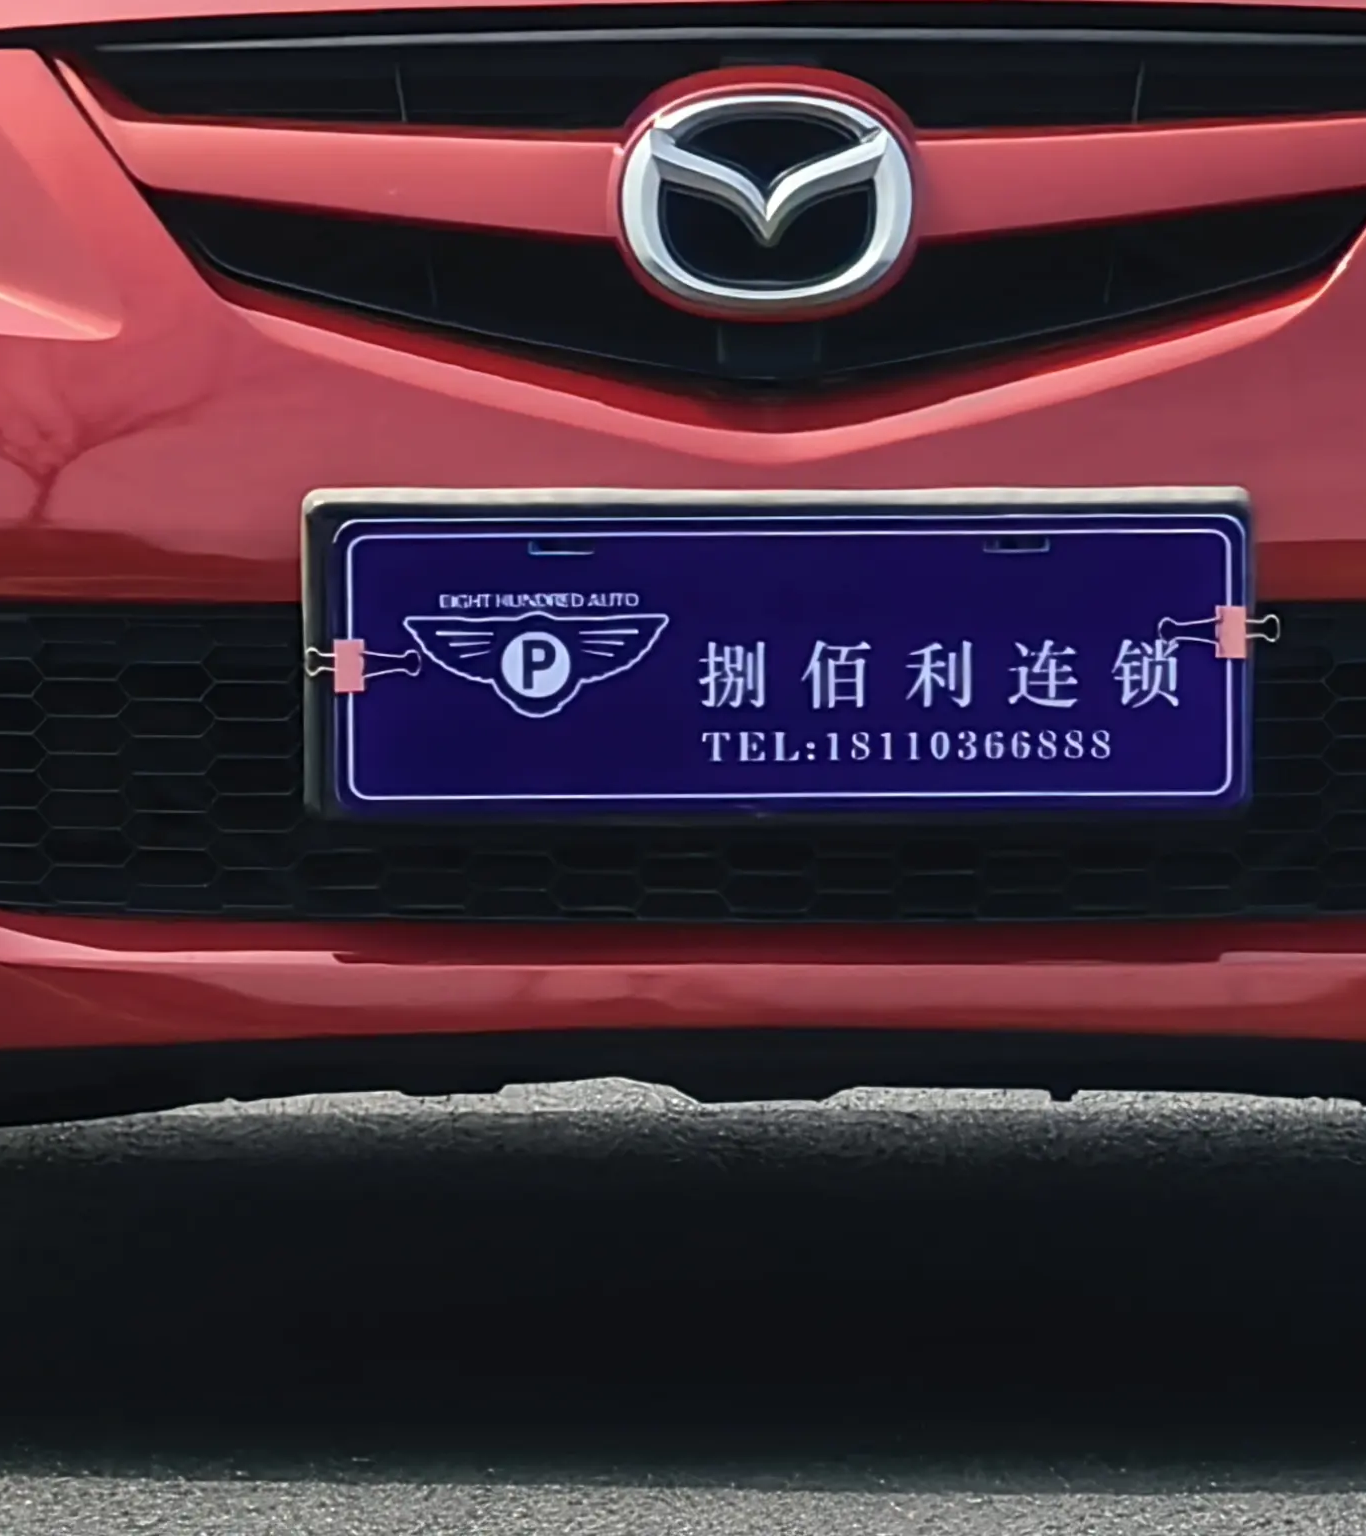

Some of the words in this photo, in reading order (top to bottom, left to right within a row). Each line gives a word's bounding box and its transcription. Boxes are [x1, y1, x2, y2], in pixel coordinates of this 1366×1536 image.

[439, 592, 490, 609] EIGHT
[495, 592, 584, 609] HUNDRED
[587, 592, 639, 608] AUTO
[520, 640, 557, 691] P
[698, 637, 1181, 709] 捌佰利连锁
[701, 729, 1113, 762] TEL:18110366888
